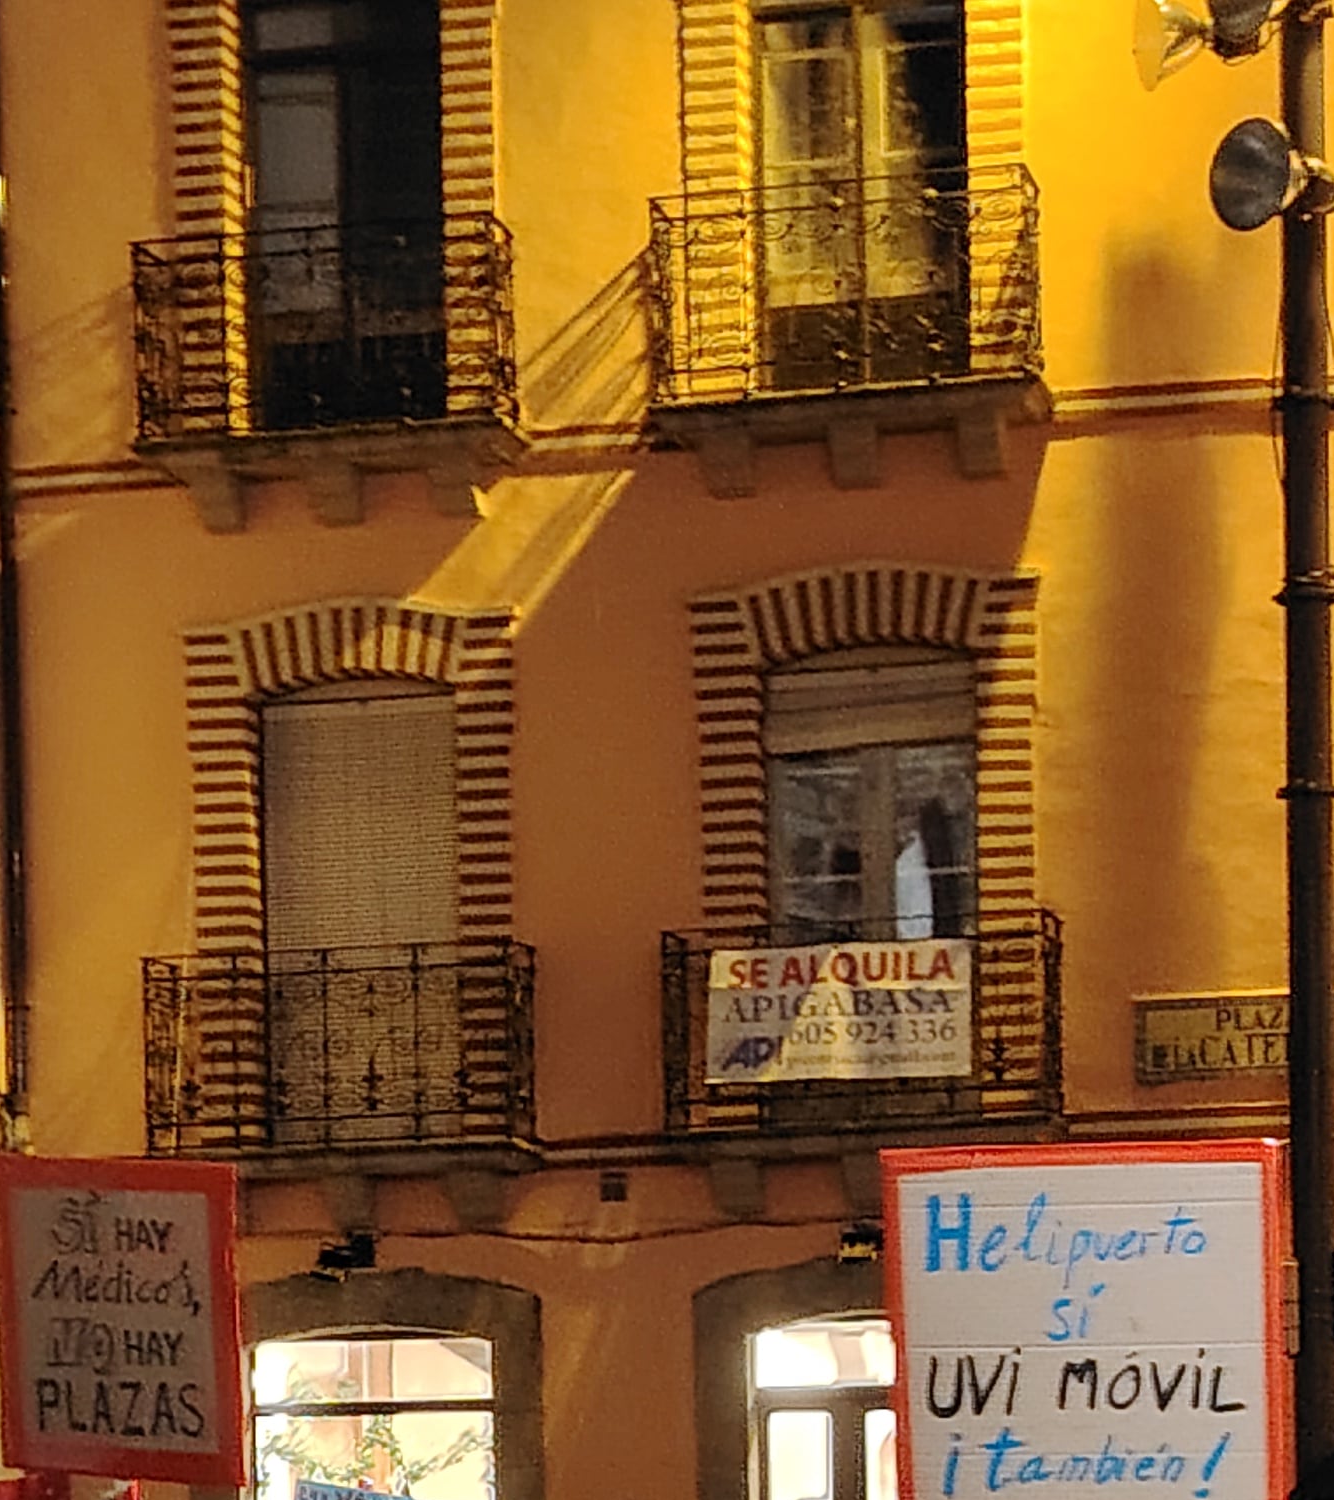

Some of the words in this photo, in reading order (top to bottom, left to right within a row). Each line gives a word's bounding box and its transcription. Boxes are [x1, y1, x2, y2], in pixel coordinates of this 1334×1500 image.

[728, 957, 768, 988] SE
[778, 948, 955, 987] ALQUILA
[906, 1019, 957, 1044] 336
[1216, 1005, 1287, 1031] PLAZ
[114, 1217, 174, 1252] HAY
[923, 1191, 1207, 1290] Helipuerto
[122, 1328, 184, 1367] HAY
[34, 1377, 206, 1438] PLAZAS
